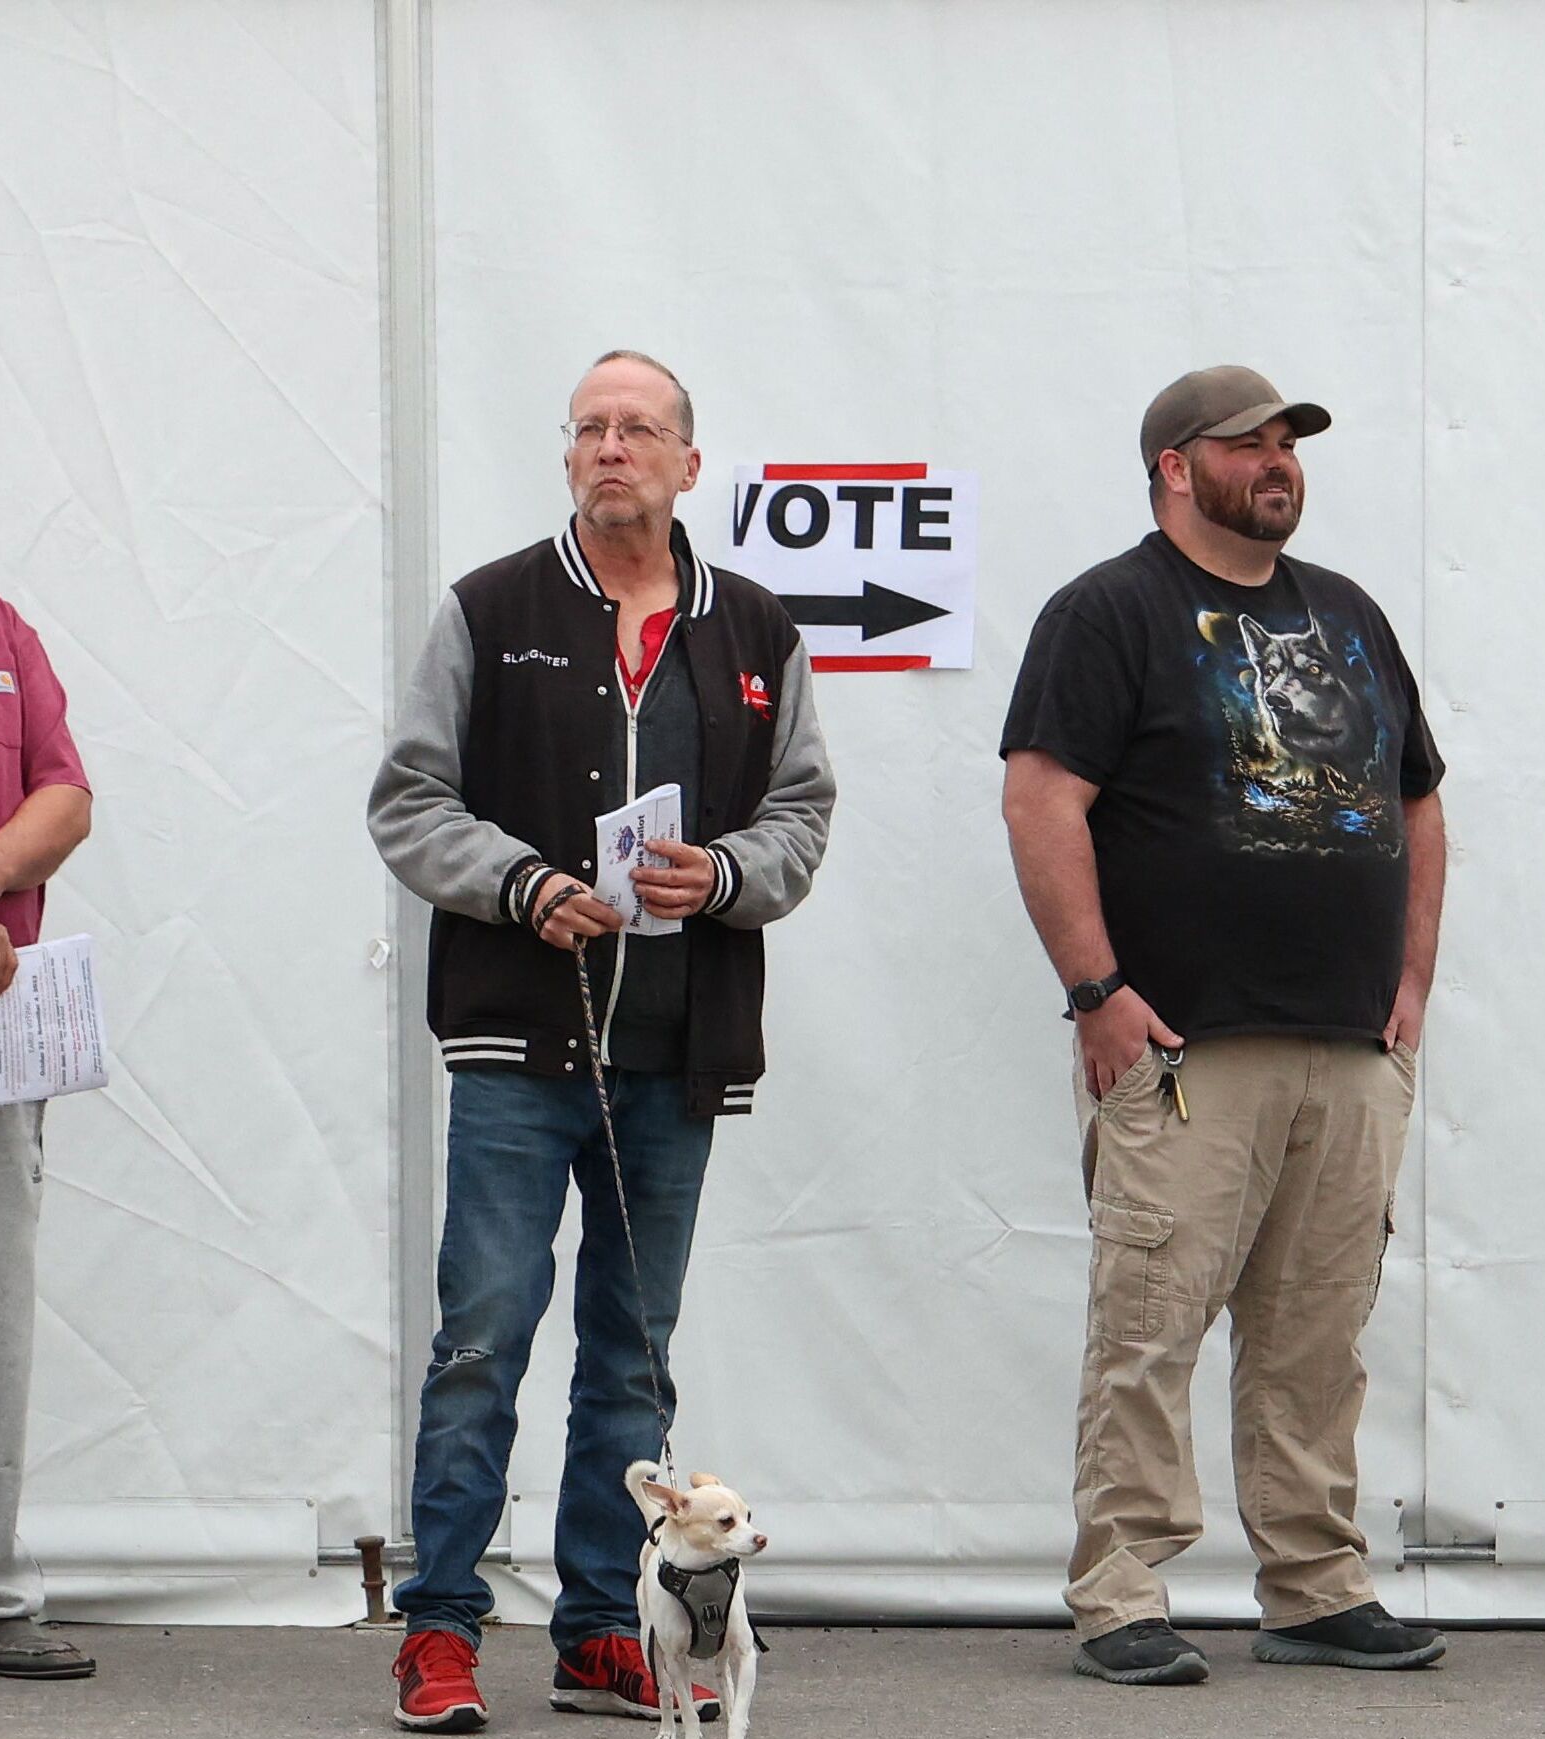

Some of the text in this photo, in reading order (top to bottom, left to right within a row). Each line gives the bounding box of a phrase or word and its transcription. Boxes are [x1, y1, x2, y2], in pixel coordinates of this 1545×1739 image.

[733, 483, 952, 551] VOTE
[503, 649, 569, 667] SLAUGHTER
[629, 815, 646, 927] Official ple Ballot
